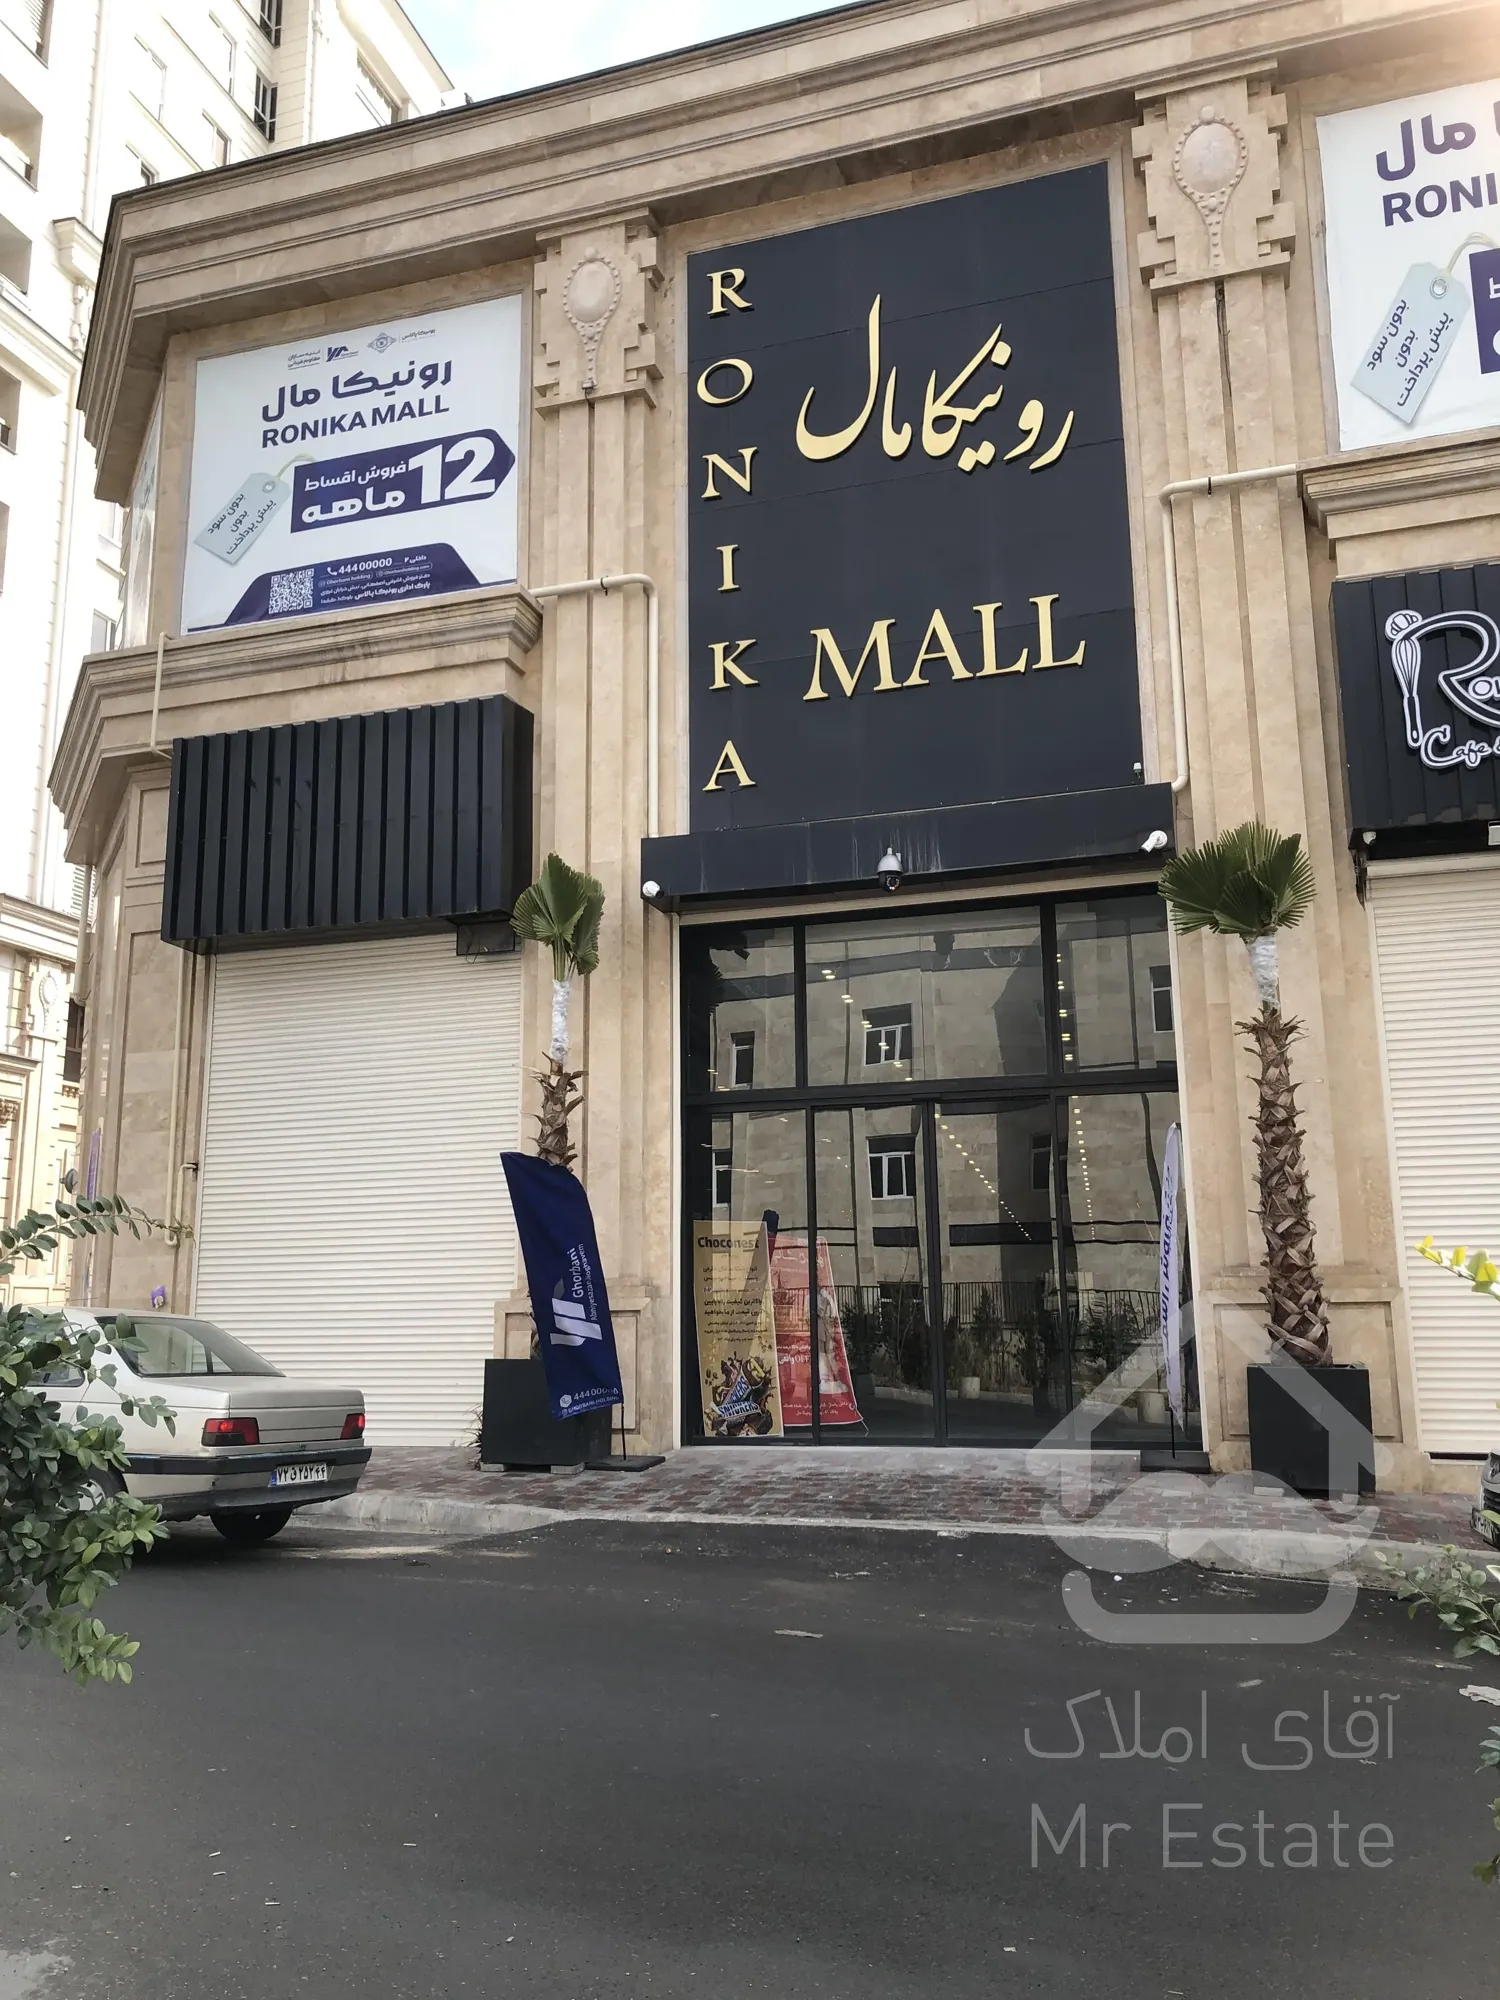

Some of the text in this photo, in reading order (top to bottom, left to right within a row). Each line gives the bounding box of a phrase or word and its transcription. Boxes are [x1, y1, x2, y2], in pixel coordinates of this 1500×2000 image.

[1376, 113, 1477, 181] مال
[1367, 299, 1408, 371] بدون سود
[1396, 329, 1416, 369] بدون
[1397, 311, 1454, 408] پیش پرداخت
[262, 360, 452, 423] رونیکا مال
[795, 293, 1075, 472] رونیکا مال
[262, 394, 450, 448] RONIKA MALL
[304, 461, 407, 491] فروش اقساط
[408, 436, 496, 504] 12
[208, 494, 246, 534] بدون سود
[226, 500, 276, 555] پیش پرداخت
[230, 510, 249, 533] بدون
[302, 486, 406, 523] ماهه
[338, 557, 392, 575] 44400000
[802, 593, 1087, 701] MALL
[567, 1247, 584, 1298] Ghorbani
